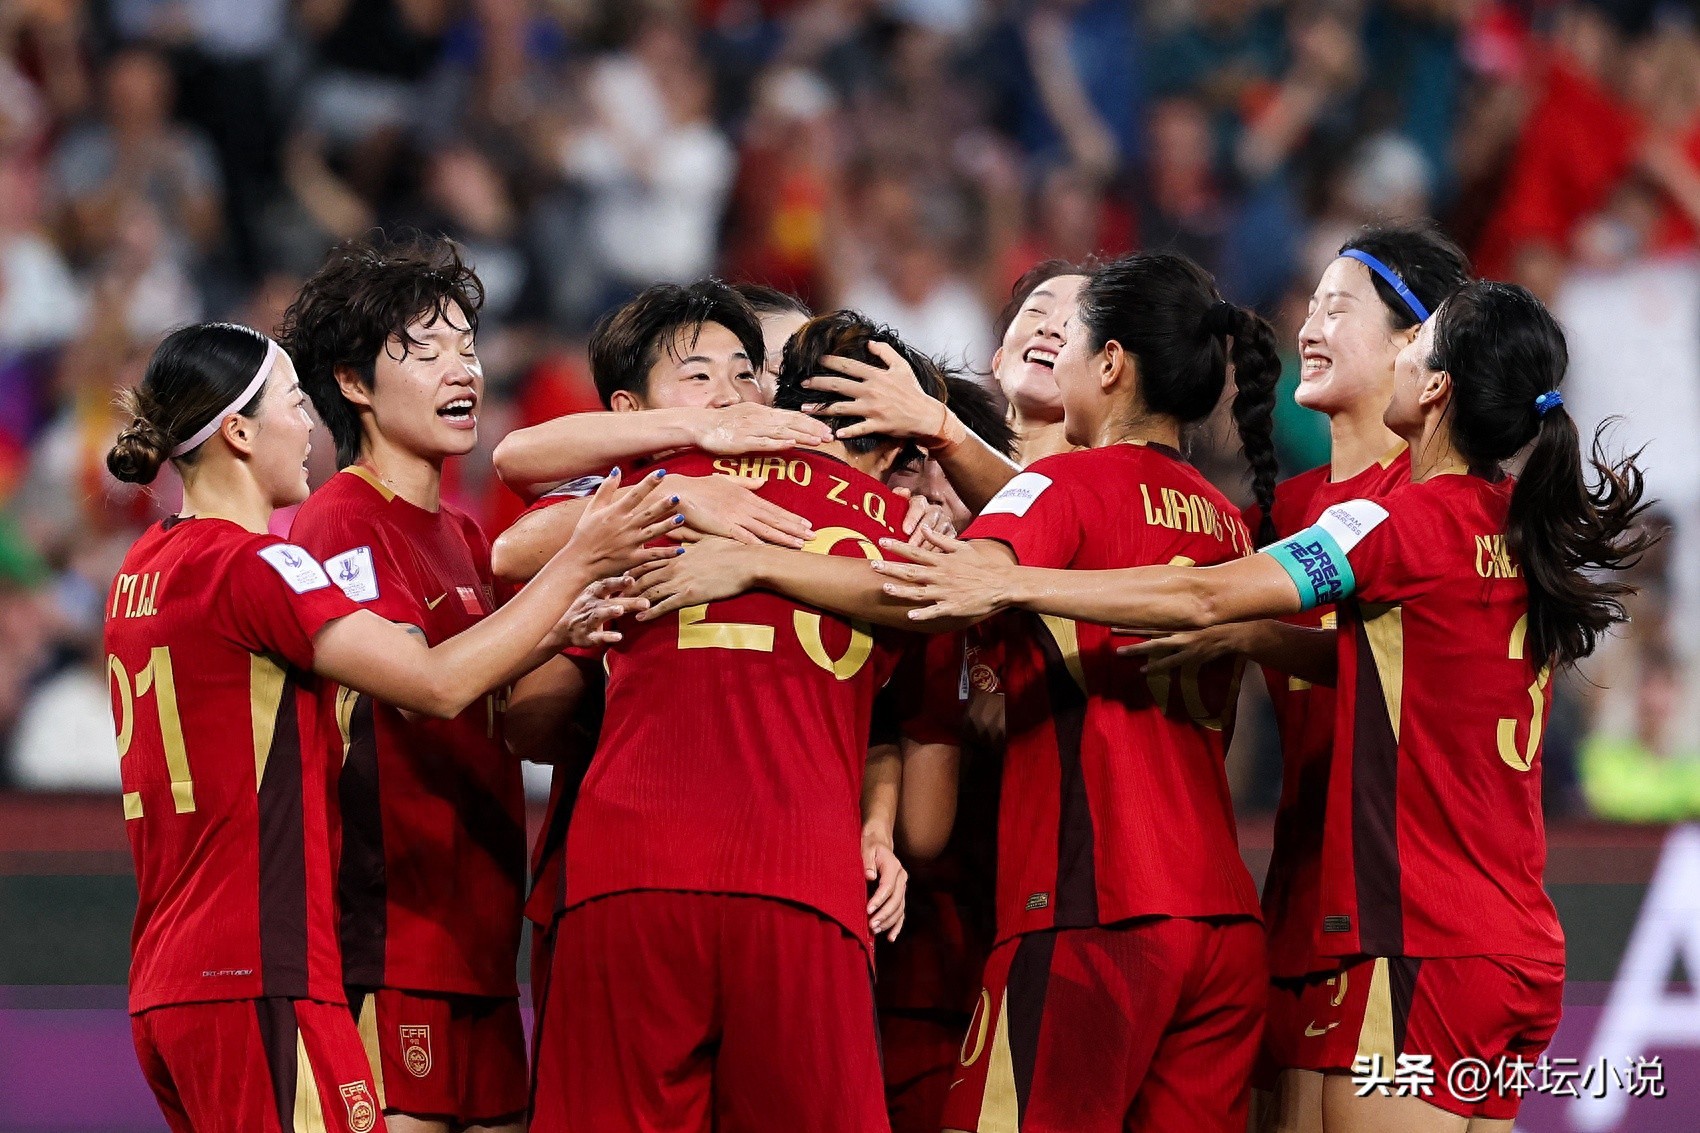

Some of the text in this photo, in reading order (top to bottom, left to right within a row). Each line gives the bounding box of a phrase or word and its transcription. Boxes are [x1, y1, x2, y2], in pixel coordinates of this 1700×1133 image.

[712, 457, 895, 533] SHAO Z.Q.
[1140, 483, 1223, 542] WANG
[1336, 508, 1362, 528] DREAM
[1328, 509, 1362, 537] FEARLESS
[1475, 534, 1524, 578] CHE
[1497, 611, 1552, 772] 3
[108, 646, 196, 821] 21
[402, 1029, 427, 1038] CFA
